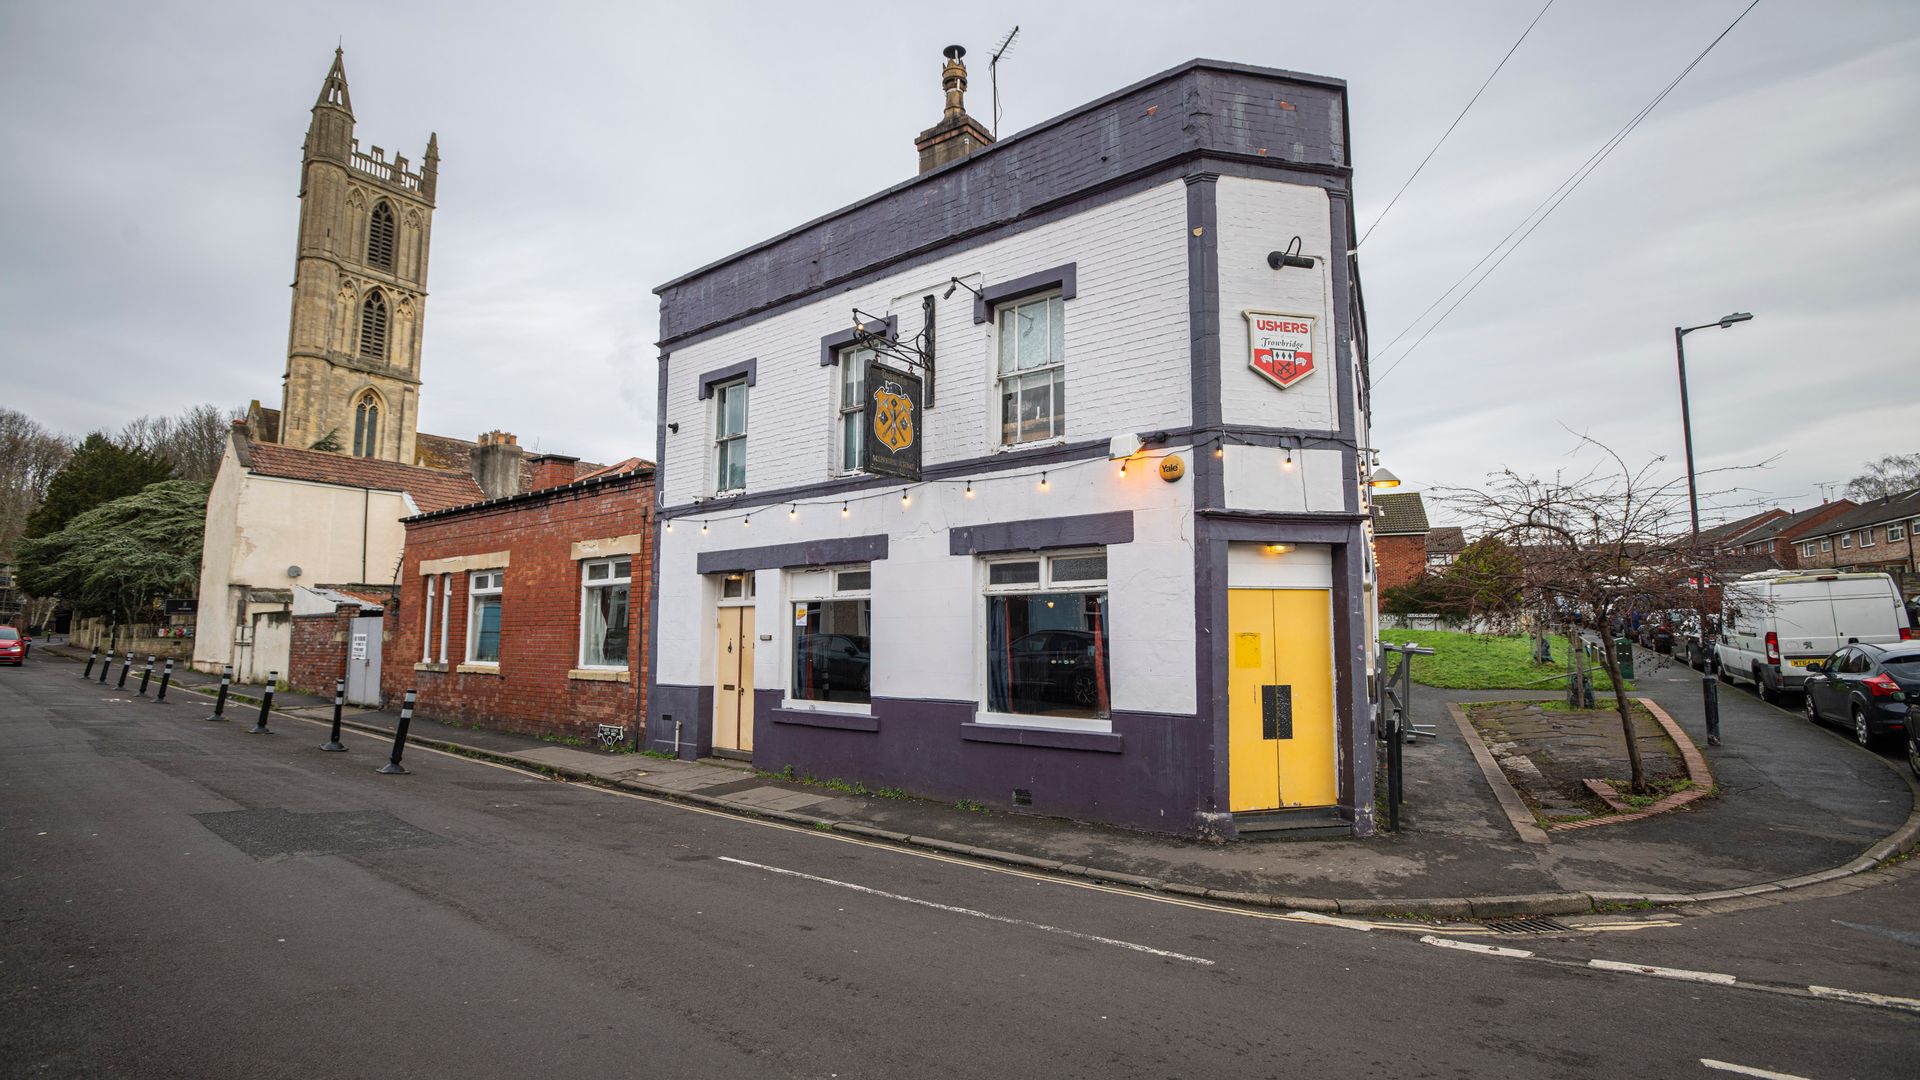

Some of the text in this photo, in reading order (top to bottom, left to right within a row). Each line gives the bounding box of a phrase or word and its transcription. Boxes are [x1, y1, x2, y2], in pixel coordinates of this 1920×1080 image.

[1256, 319, 1309, 334] USHERS
[1261, 337, 1304, 350] Trowbridge
[1162, 463, 1178, 473] Yale
